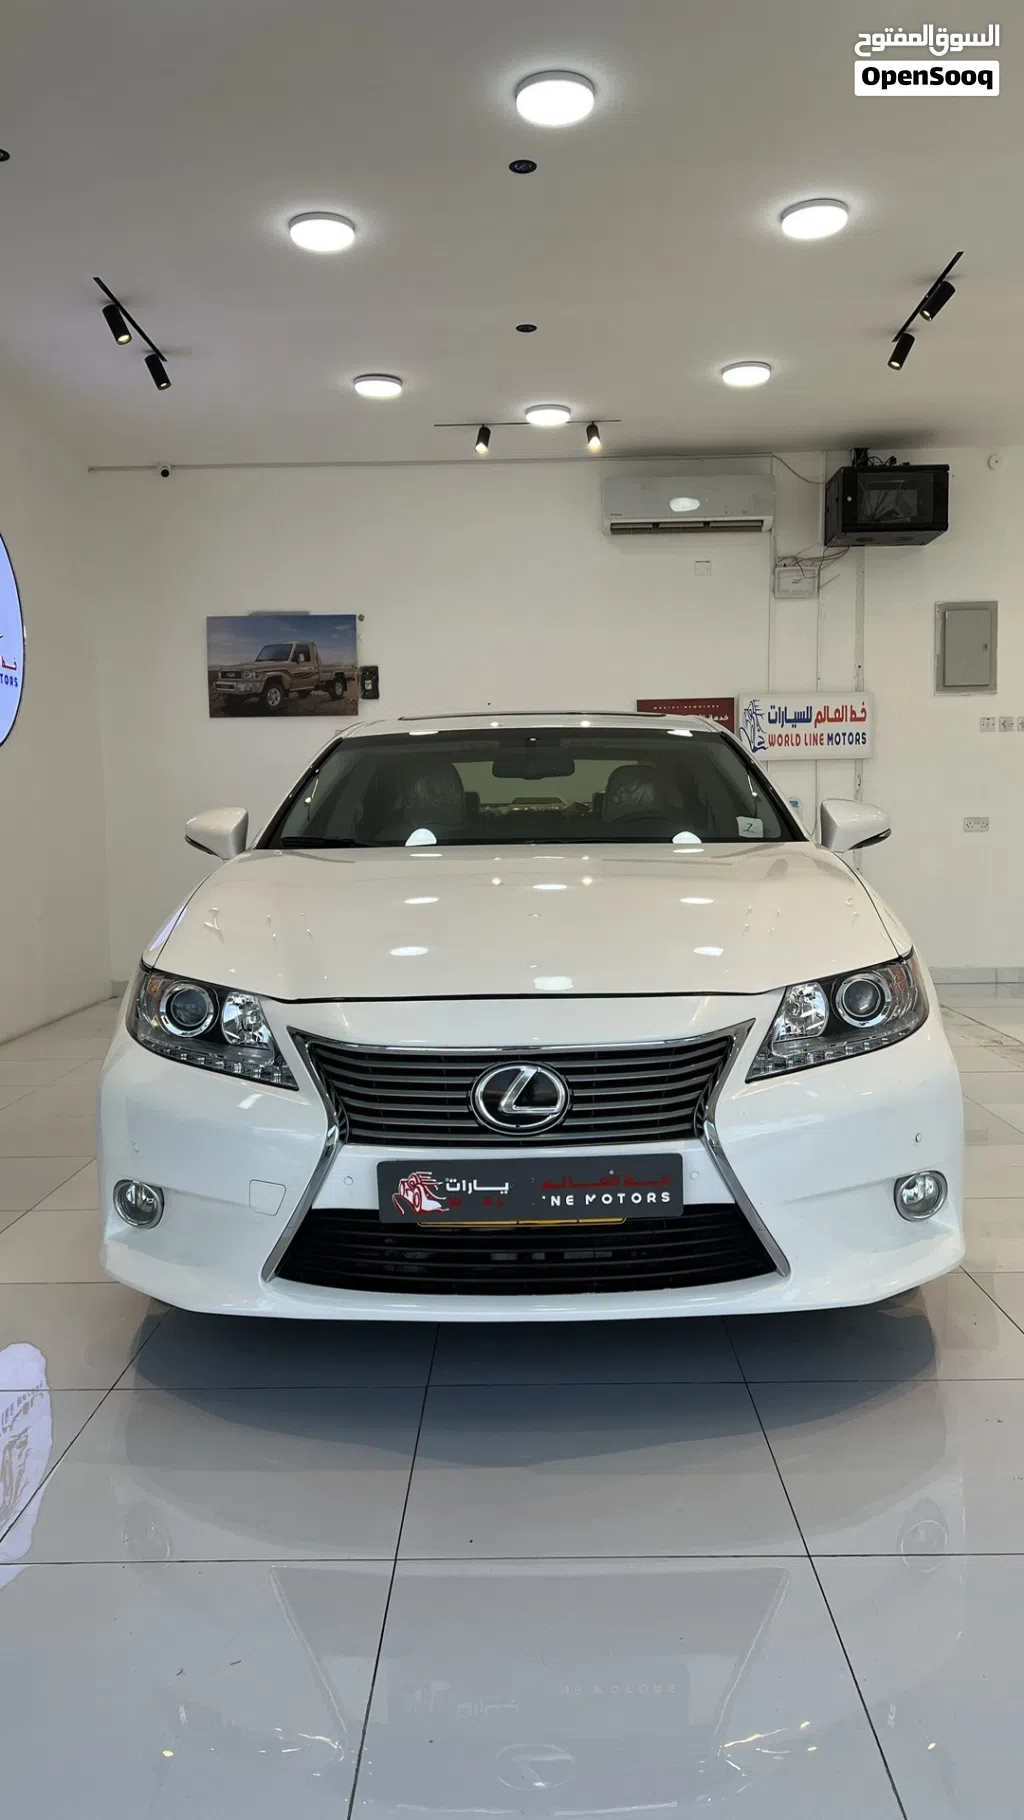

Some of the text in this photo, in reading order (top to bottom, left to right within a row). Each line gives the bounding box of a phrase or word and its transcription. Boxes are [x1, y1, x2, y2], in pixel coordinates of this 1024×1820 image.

[767, 701, 867, 729] خط العالم للسيارات
[768, 732, 867, 747] WORLD LINE MOTORS
[541, 1191, 671, 1207] NE MOTORS
